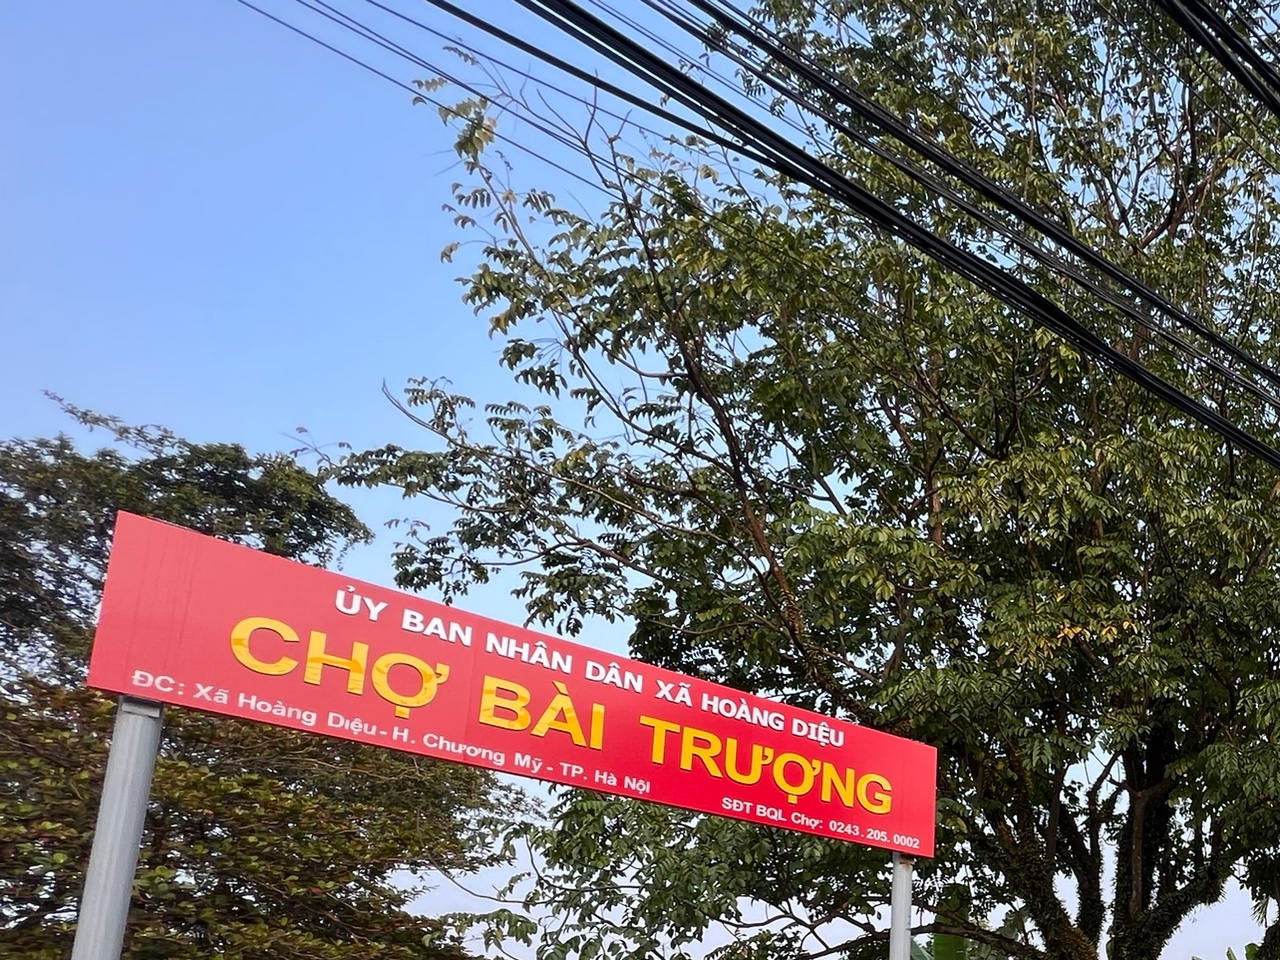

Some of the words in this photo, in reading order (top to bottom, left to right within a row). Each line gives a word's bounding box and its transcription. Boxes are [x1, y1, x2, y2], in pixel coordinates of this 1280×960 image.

[132, 670, 184, 695] ĐC:
[193, 683, 229, 705] Xã
[238, 692, 317, 726] Hoàng
[423, 733, 505, 766] Chương
[514, 752, 543, 774] Mỹ
[595, 770, 617, 786] Hà
[624, 776, 650, 794] Nội
[231, 617, 450, 719] CHỢ
[479, 675, 605, 751] BÀI
[640, 716, 893, 815] TRƯỢNG
[335, 585, 388, 621] ỦY
[401, 609, 472, 647] BAN
[485, 632, 572, 674] NHÂN
[585, 660, 642, 693] DÂN
[655, 680, 692, 707] XÃ
[701, 693, 785, 730] HOÀNG
[792, 718, 844, 747] DIỆU
[721, 797, 753, 814] SĐT
[756, 805, 787, 821] BQL
[791, 812, 823, 830] Chợ:
